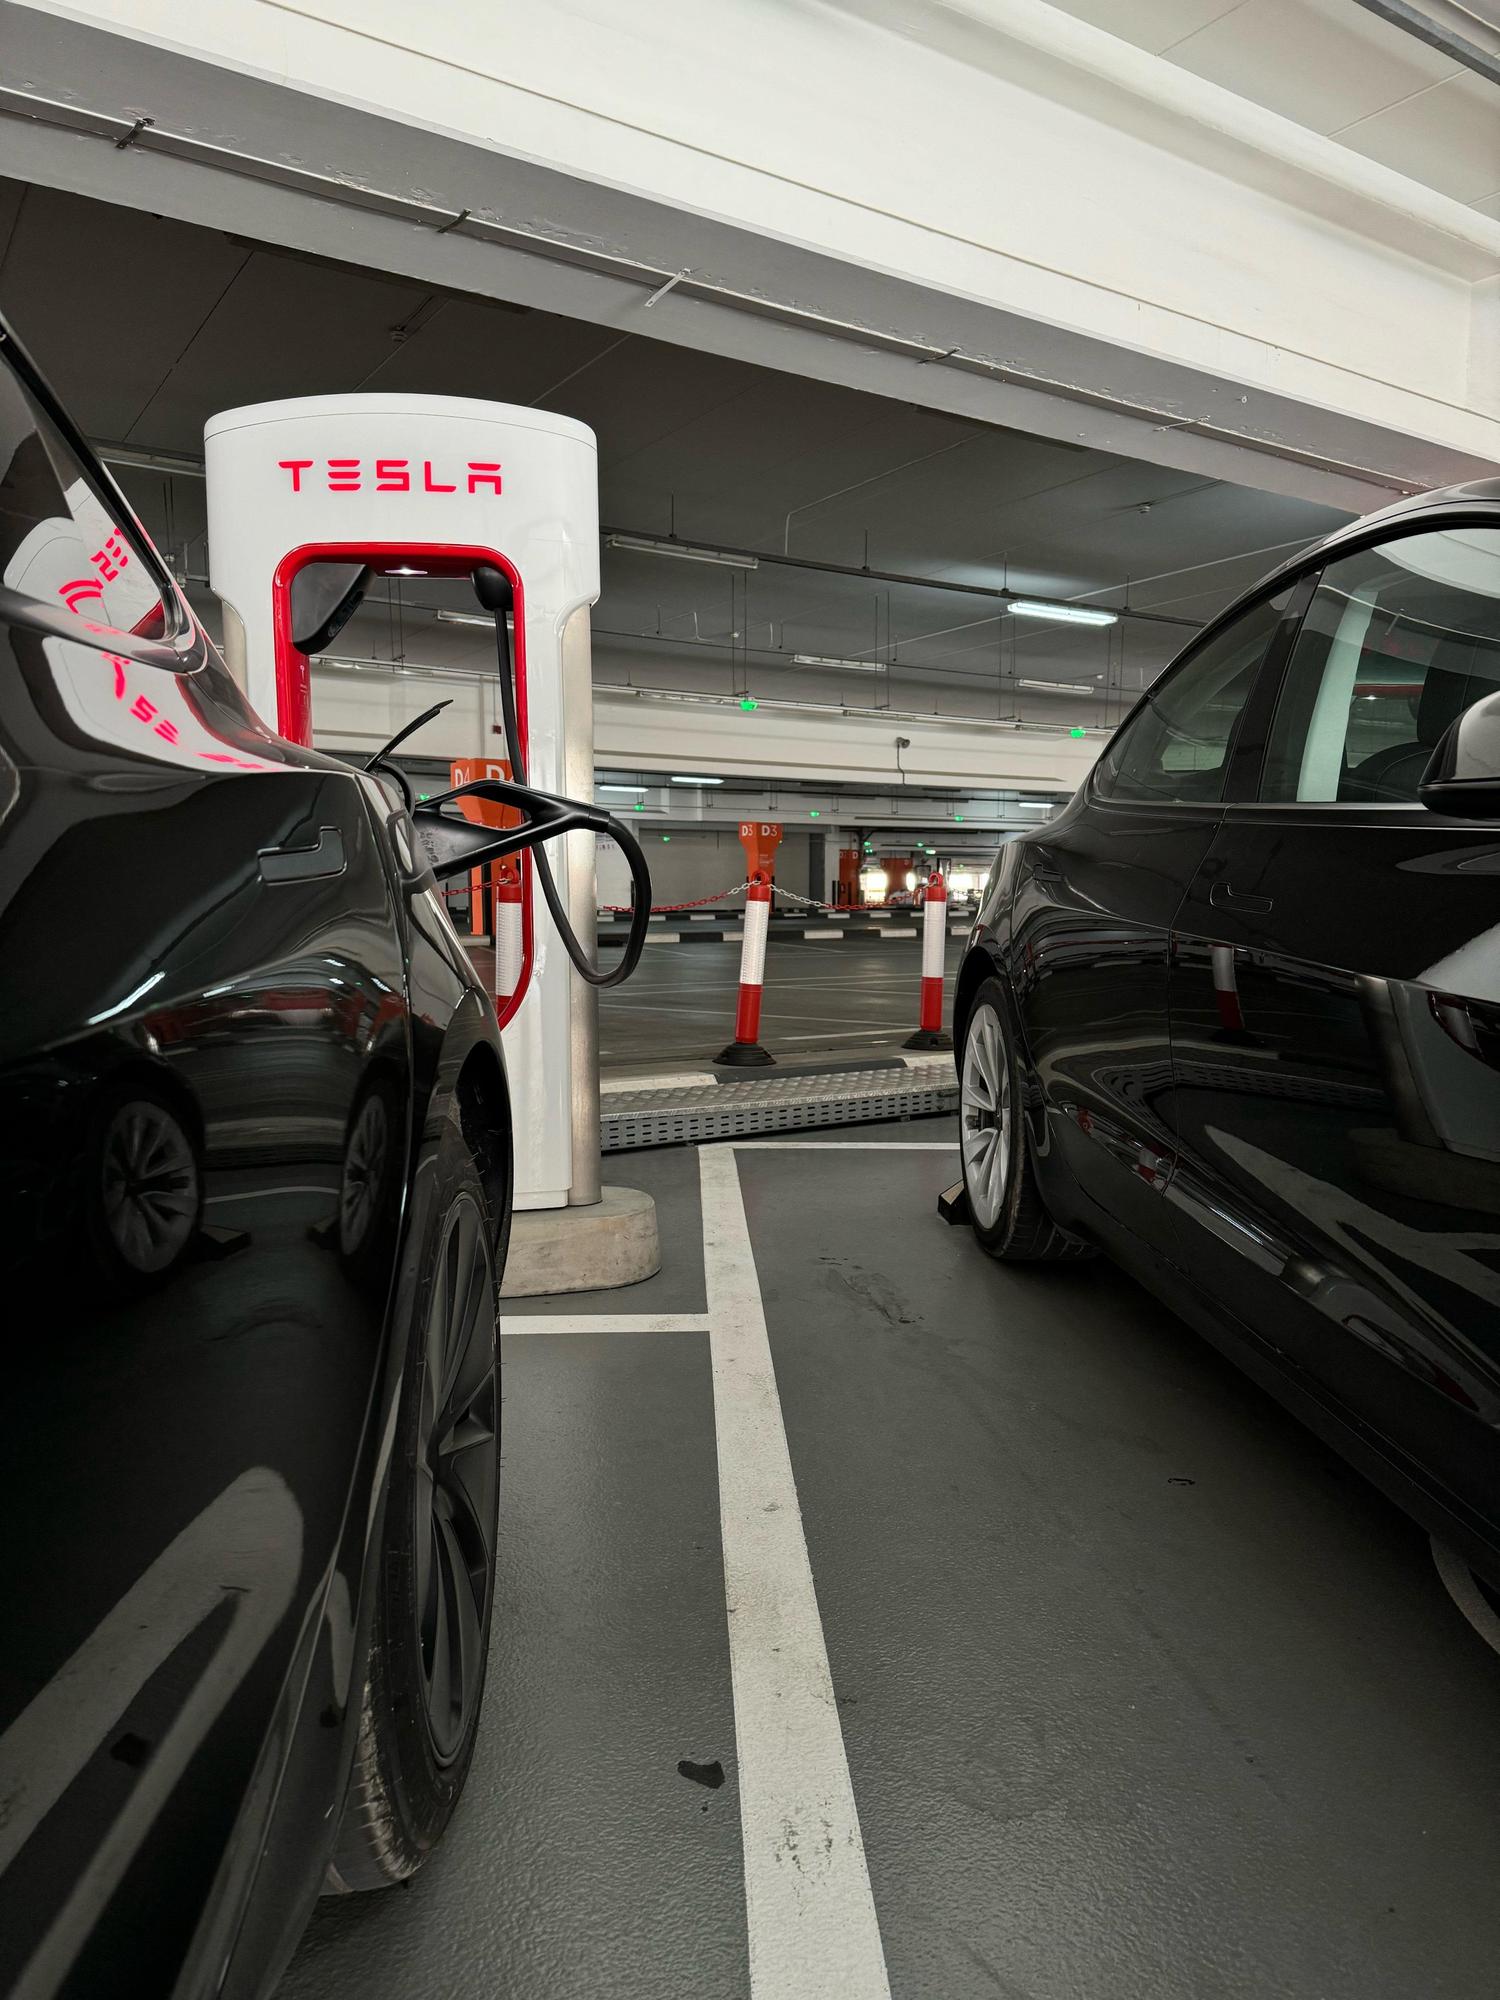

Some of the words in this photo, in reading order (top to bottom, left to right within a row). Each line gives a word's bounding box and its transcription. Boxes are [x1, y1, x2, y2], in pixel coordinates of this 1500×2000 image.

[278, 460, 502, 495] TESLA
[455, 767, 470, 787] D4
[742, 825, 753, 836] D3
[762, 825, 777, 837] D3
